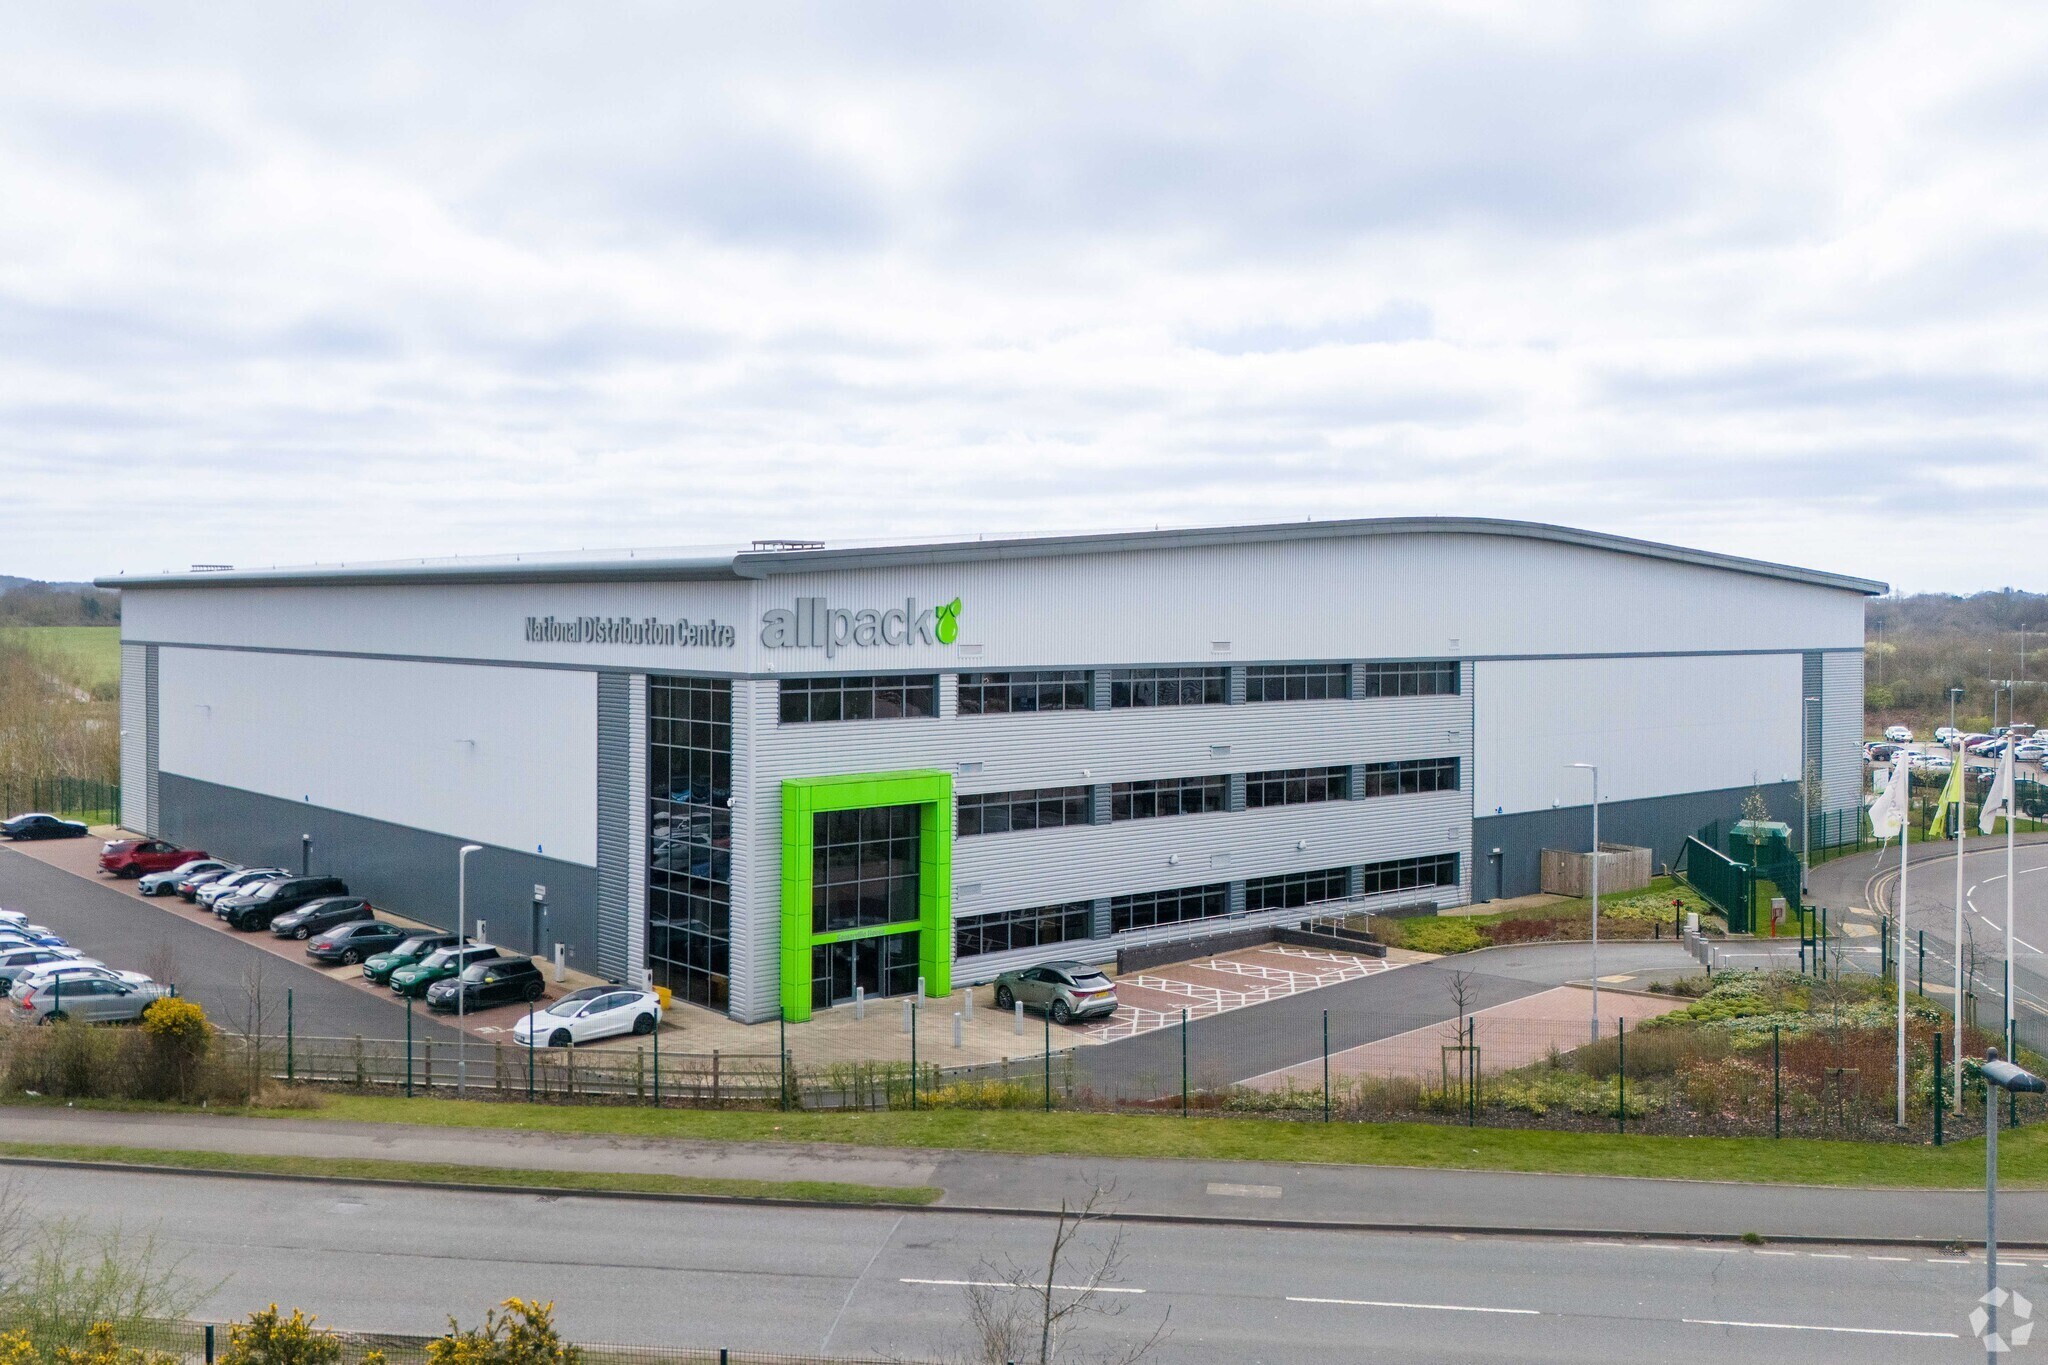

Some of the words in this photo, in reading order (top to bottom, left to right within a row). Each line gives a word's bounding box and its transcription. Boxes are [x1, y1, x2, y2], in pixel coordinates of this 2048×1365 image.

[525, 616, 582, 643] National
[582, 616, 675, 645] Distribution
[675, 618, 736, 647] Centre
[761, 597, 934, 658] allpack
